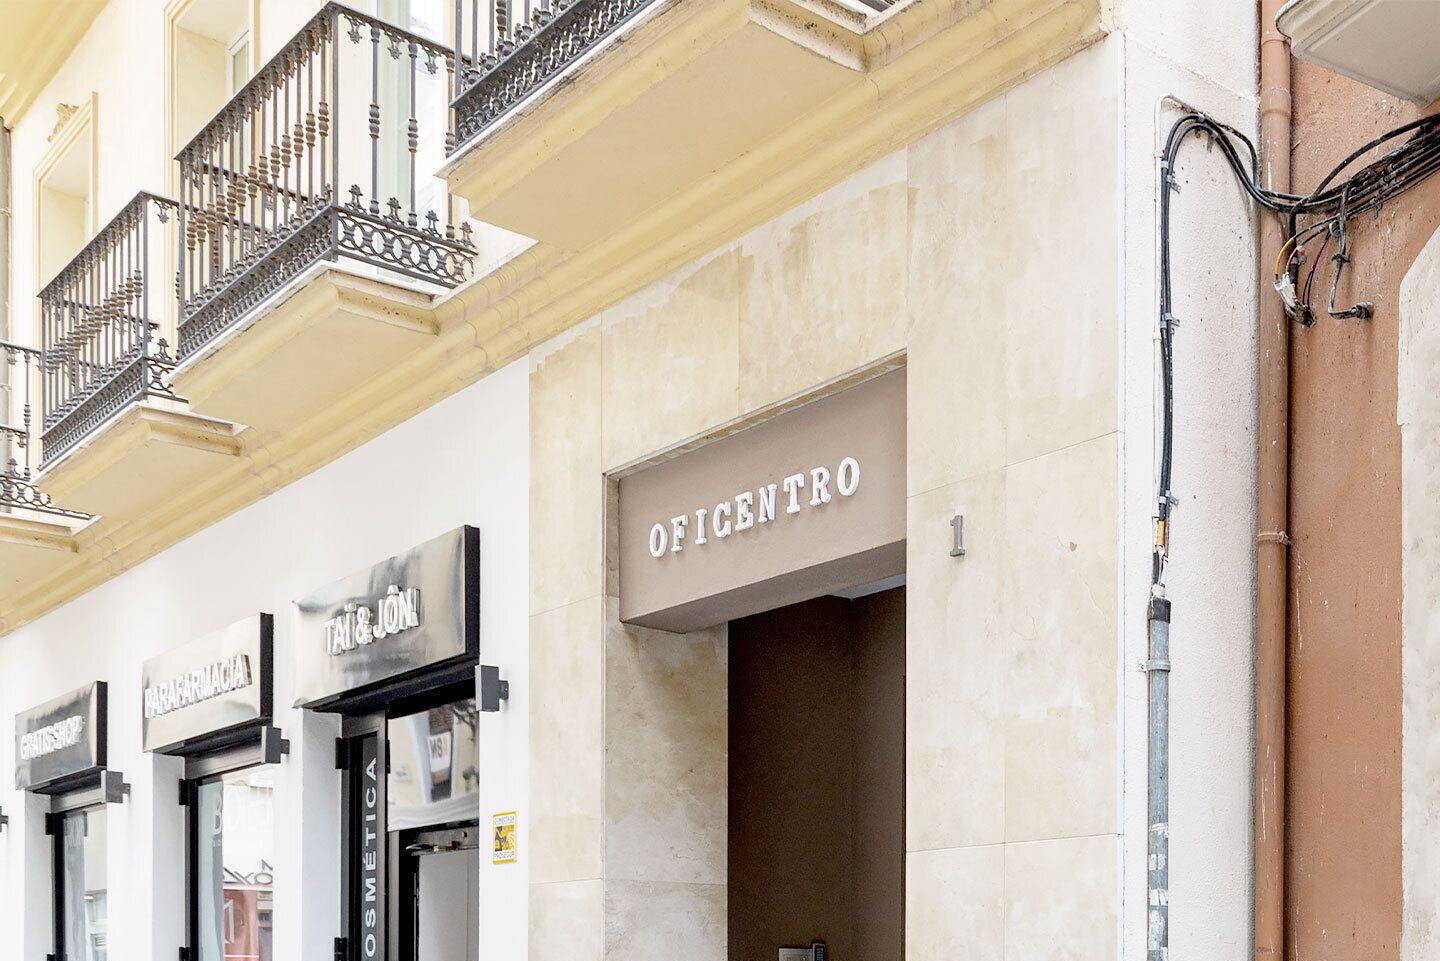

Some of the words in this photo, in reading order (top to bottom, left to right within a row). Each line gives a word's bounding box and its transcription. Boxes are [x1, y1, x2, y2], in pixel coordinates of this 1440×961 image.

[648, 456, 861, 559] OFICENTRO
[950, 515, 966, 557] 1
[144, 653, 252, 719] PARAFARMACIA
